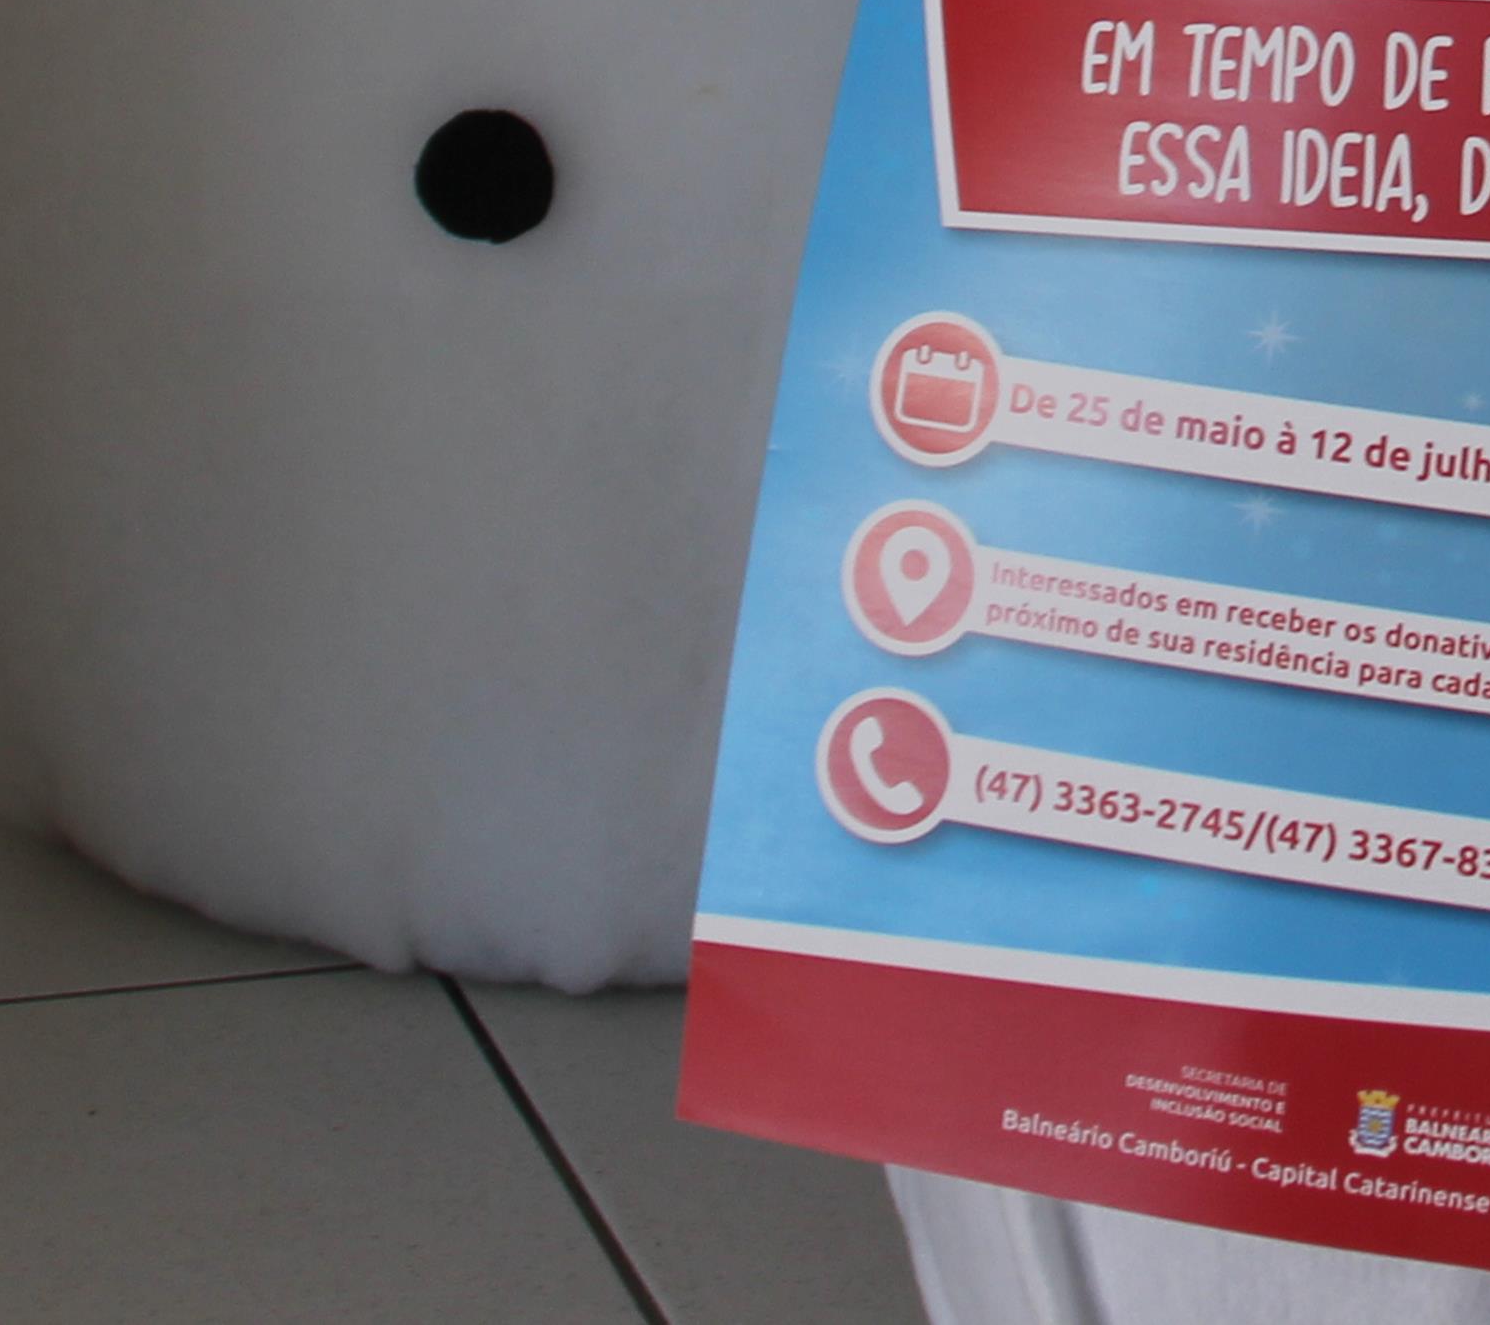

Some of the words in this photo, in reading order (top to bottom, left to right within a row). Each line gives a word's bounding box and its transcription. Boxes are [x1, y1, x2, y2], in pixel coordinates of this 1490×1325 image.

[1082, 20, 1153, 98] EM
[1184, 23, 1355, 106] TEMPO
[1385, 33, 1450, 113] DE
[1117, 120, 1251, 204] ESSA
[1280, 126, 1428, 224] IDEIA,
[1009, 383, 1057, 419] De
[1066, 392, 1110, 427] 25
[1120, 401, 1165, 435] de
[1175, 414, 1266, 451] maio
[1276, 421, 1297, 455] à
[1311, 429, 1353, 463] 12
[1364, 435, 1411, 471] de
[986, 602, 1099, 639] próximo
[1106, 618, 1141, 646] de
[1148, 629, 1195, 655] sua
[1203, 638, 1350, 679] residência
[1359, 662, 1423, 690] para
[990, 562, 1168, 612] Interessados
[1175, 597, 1218, 621] em
[1226, 605, 1336, 638] receber
[1344, 623, 1376, 644] os
[975, 764, 1044, 812] (47)
[1053, 780, 1338, 863] 3363-2745/(47)
[1124, 1073, 1273, 1114] DESENVOLVIMENTO
[1275, 1101, 1287, 1116] E
[1180, 1065, 1265, 1093] SECRETARIA
[1267, 1081, 1289, 1096] DE
[1228, 1111, 1284, 1134] SOCIAL
[1001, 1108, 1113, 1150] Balneário
[1118, 1132, 1232, 1173] Camboriú
[1251, 1157, 1338, 1191] Capital
[1343, 1171, 1490, 1214] Catarinense
